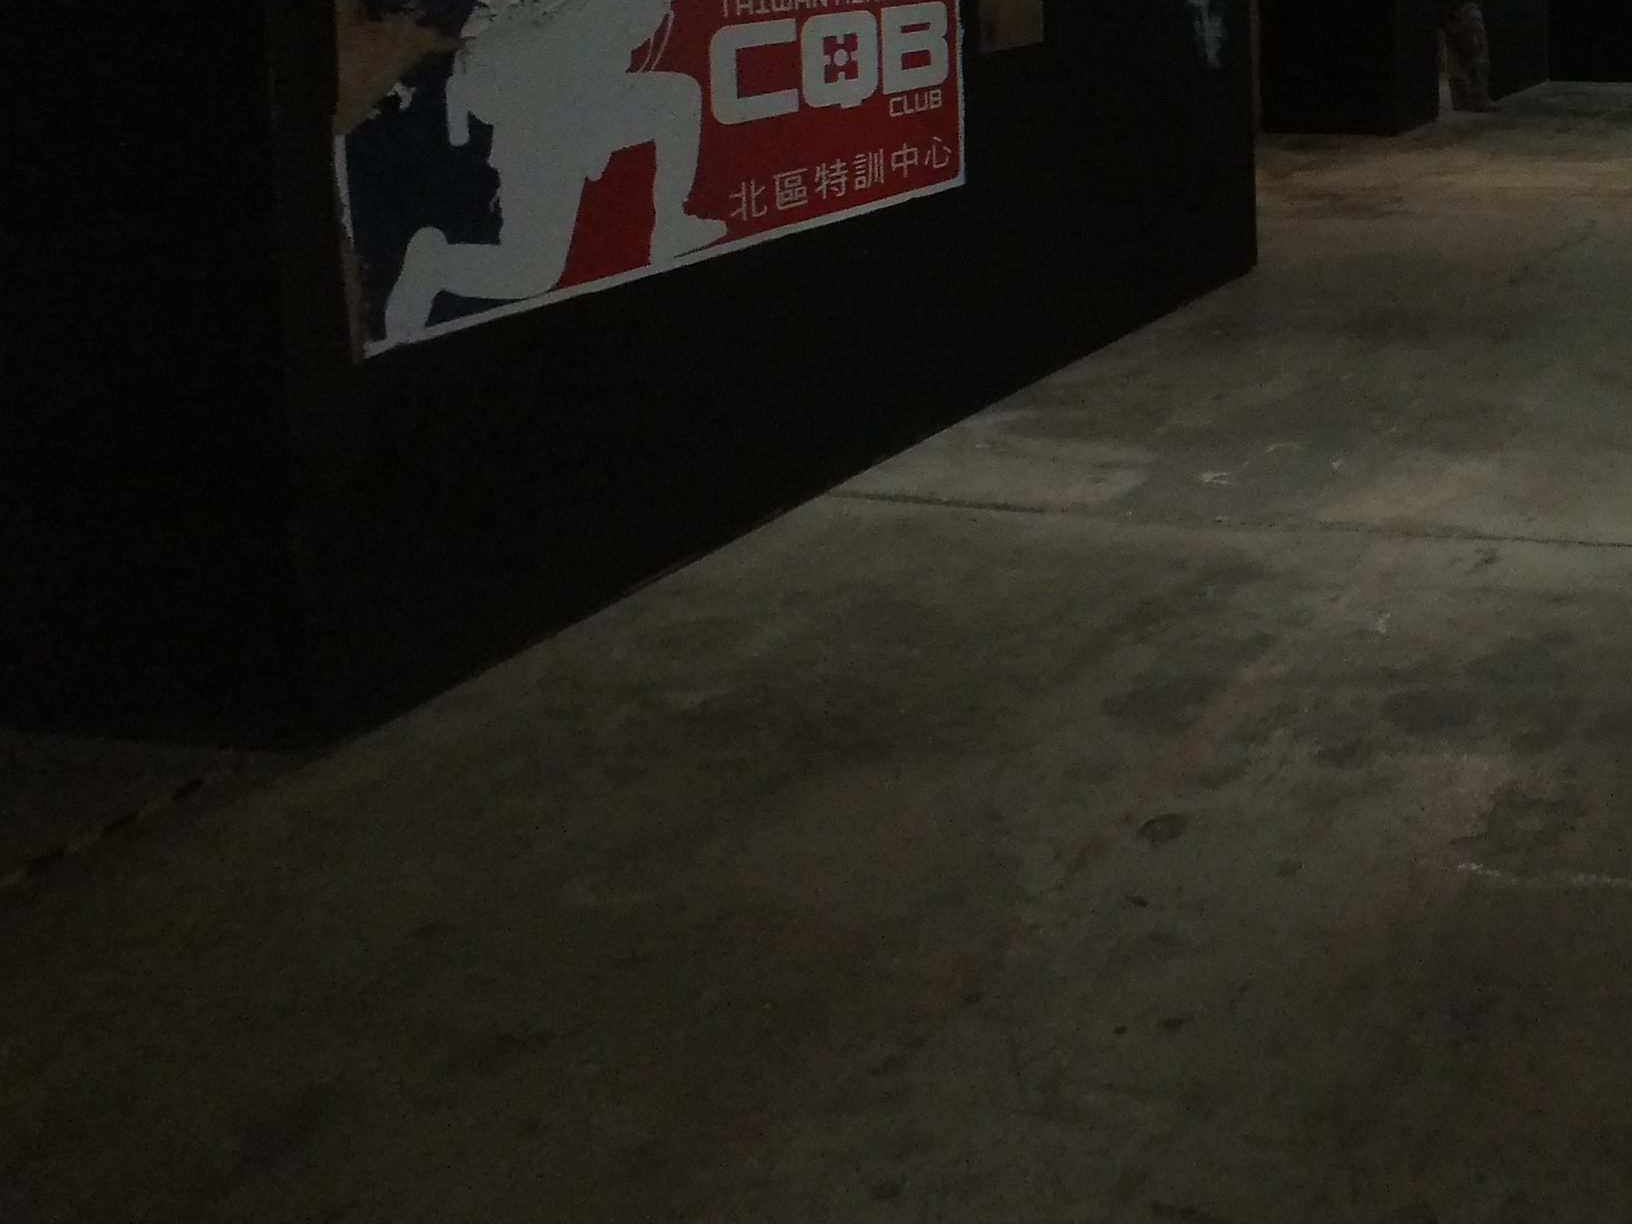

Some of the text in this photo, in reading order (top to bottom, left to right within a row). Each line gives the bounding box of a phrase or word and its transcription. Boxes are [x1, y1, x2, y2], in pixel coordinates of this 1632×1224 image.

[709, 1, 949, 125] CQB
[889, 89, 943, 117] CLUB
[729, 136, 952, 221] 北區特訓中心
